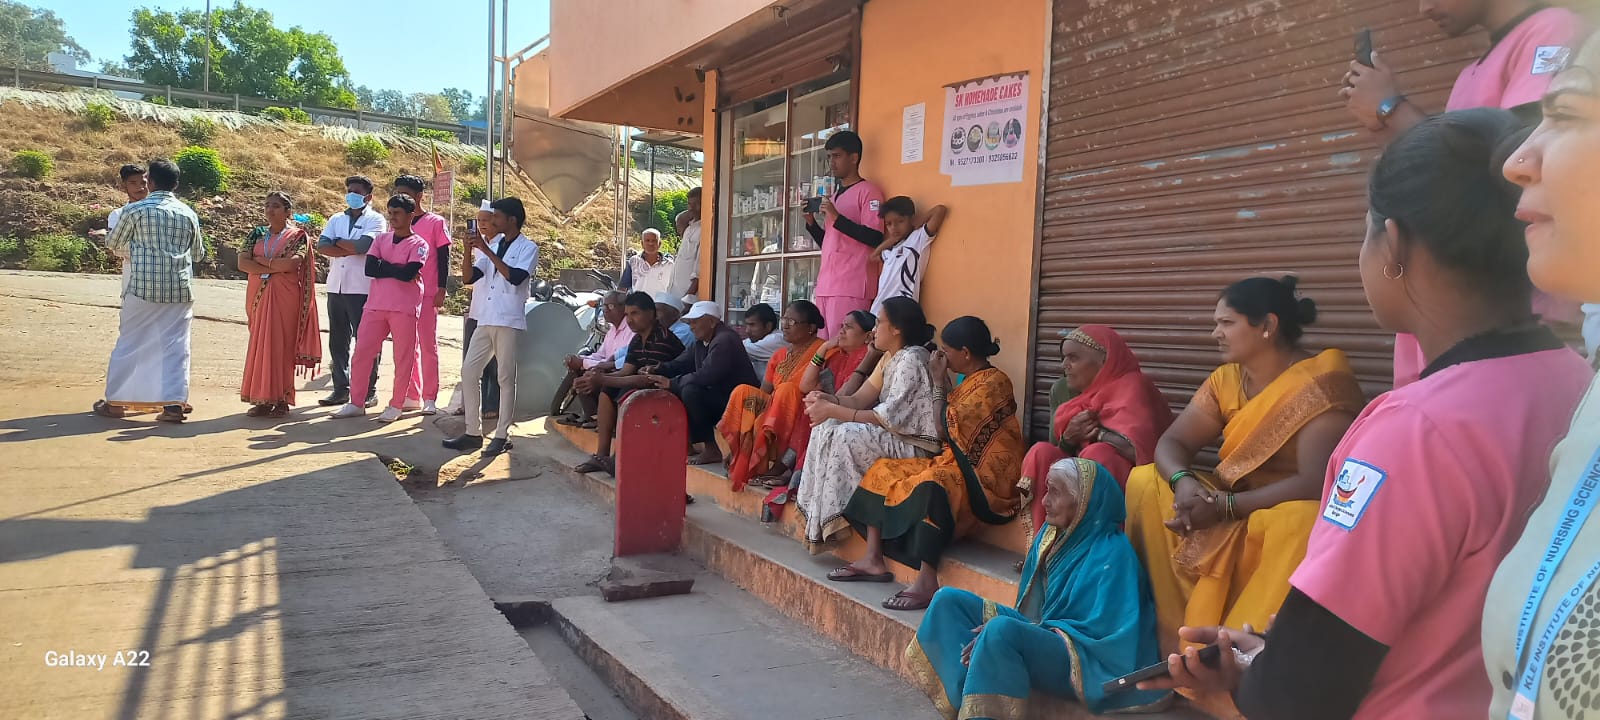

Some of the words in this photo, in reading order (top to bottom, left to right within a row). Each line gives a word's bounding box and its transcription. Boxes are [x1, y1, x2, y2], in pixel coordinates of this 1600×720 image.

[955, 94, 963, 107] SK
[964, 86, 999, 106] HOMEMADE
[999, 82, 1023, 99] CAKES
[1536, 565, 1548, 582] OF
[1545, 508, 1580, 562] NURSING
[1523, 662, 1538, 690] KLE
[1533, 598, 1571, 662] INSTITUTE
[1570, 580, 1585, 597] OF
